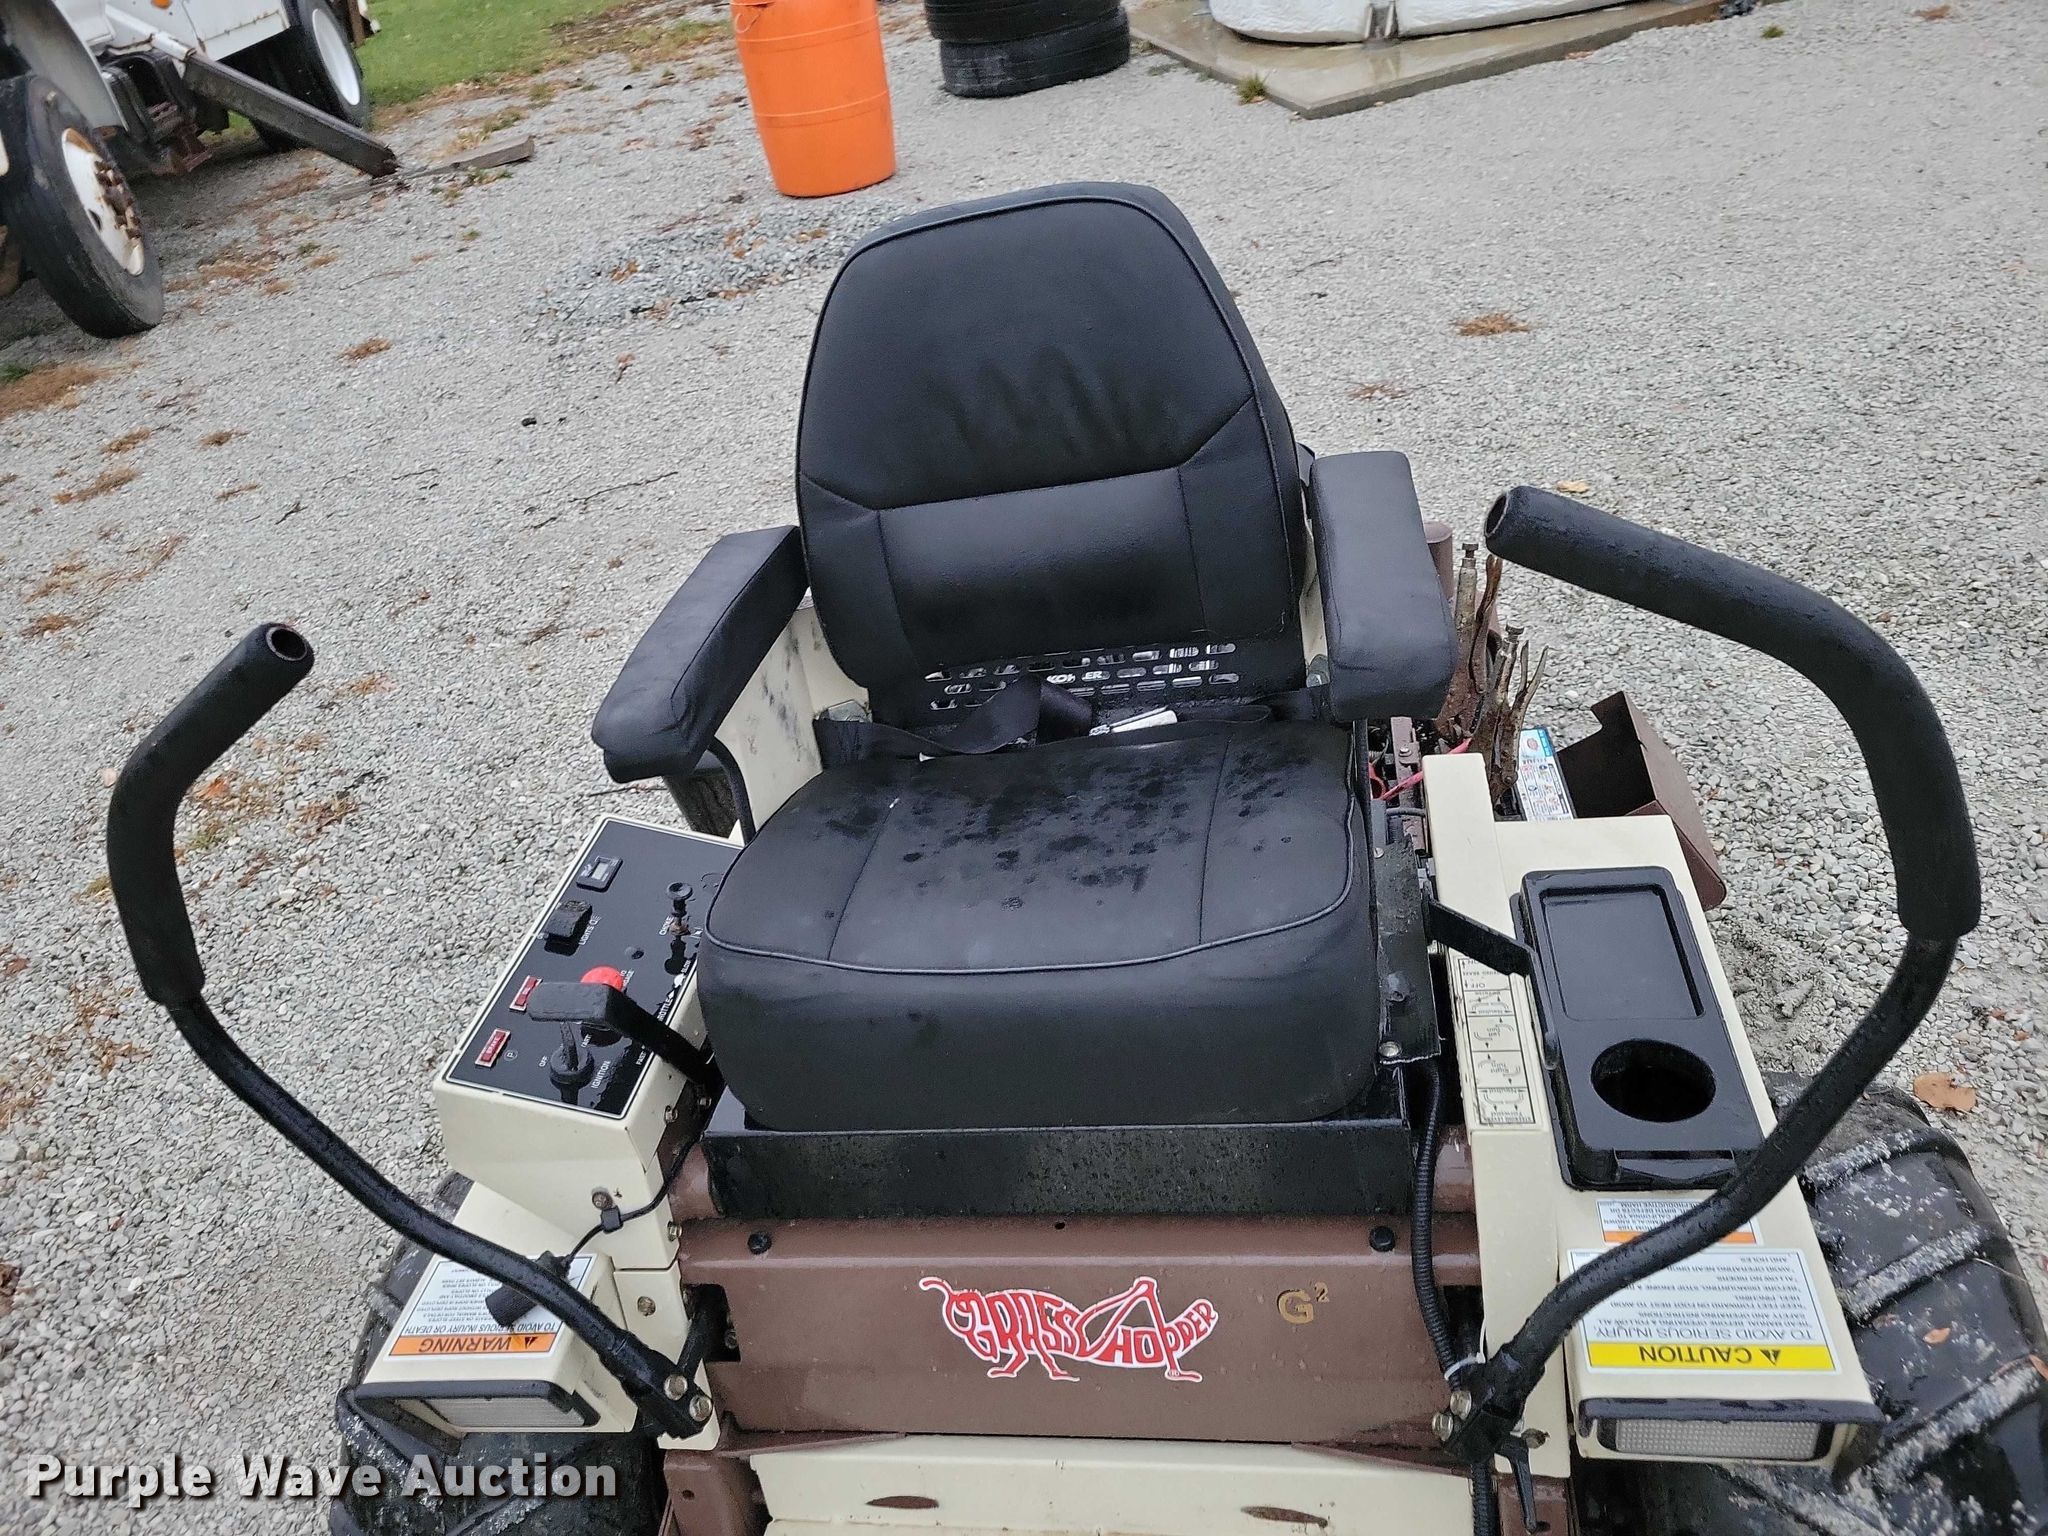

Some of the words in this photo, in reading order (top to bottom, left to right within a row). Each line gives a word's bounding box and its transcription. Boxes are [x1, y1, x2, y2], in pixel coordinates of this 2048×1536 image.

[590, 1060, 611, 1090] IGNITION
[404, 1325, 433, 1334] DEATH
[433, 1325, 447, 1333] OR
[446, 1324, 479, 1333] INJURY
[517, 1322, 545, 1332] AVOID
[543, 1322, 556, 1332] TO
[1656, 1328, 1732, 1340] SERIOUS
[1735, 1329, 1785, 1341] AVOID
[1790, 1329, 1812, 1341] TO
[418, 1336, 512, 1353] WARNING
[1638, 1346, 1754, 1365] CAUTION
